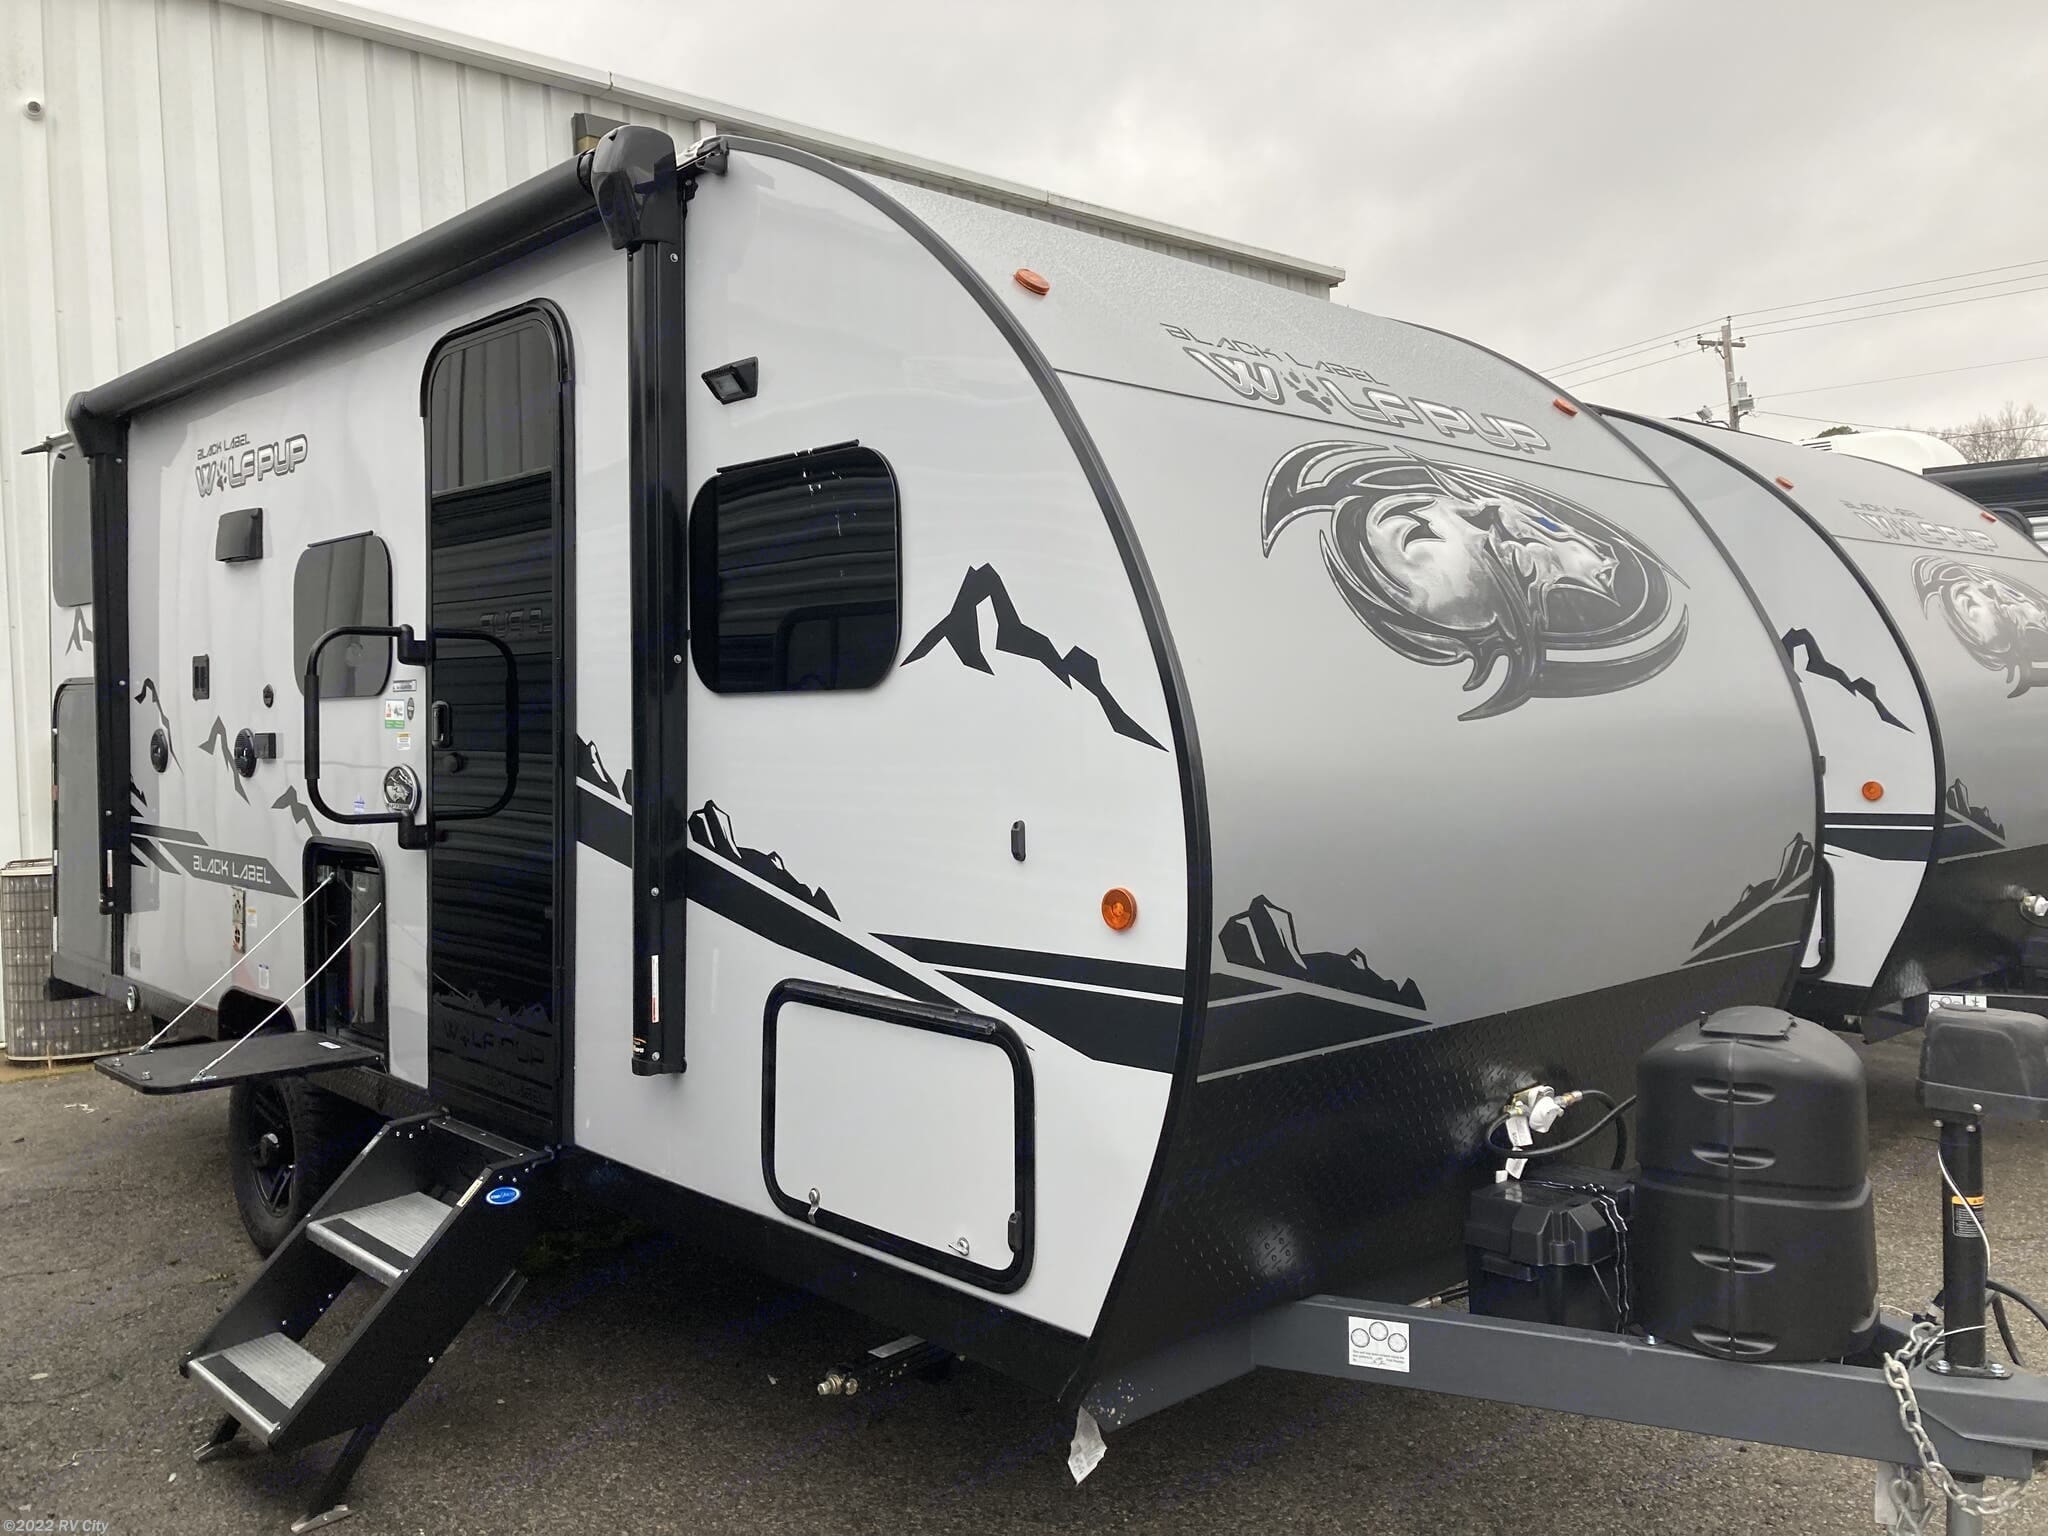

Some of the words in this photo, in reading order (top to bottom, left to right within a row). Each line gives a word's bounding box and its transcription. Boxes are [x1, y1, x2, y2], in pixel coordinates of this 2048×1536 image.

[1159, 322, 1284, 362] BLACK
[1284, 350, 1390, 387] LABEL
[196, 441, 223, 461] BLACK
[223, 433, 251, 451] LABEL
[1408, 395, 1551, 454] PUP
[257, 433, 308, 482] PUP
[193, 855, 229, 877] BLACK
[232, 862, 271, 884] LABEL
